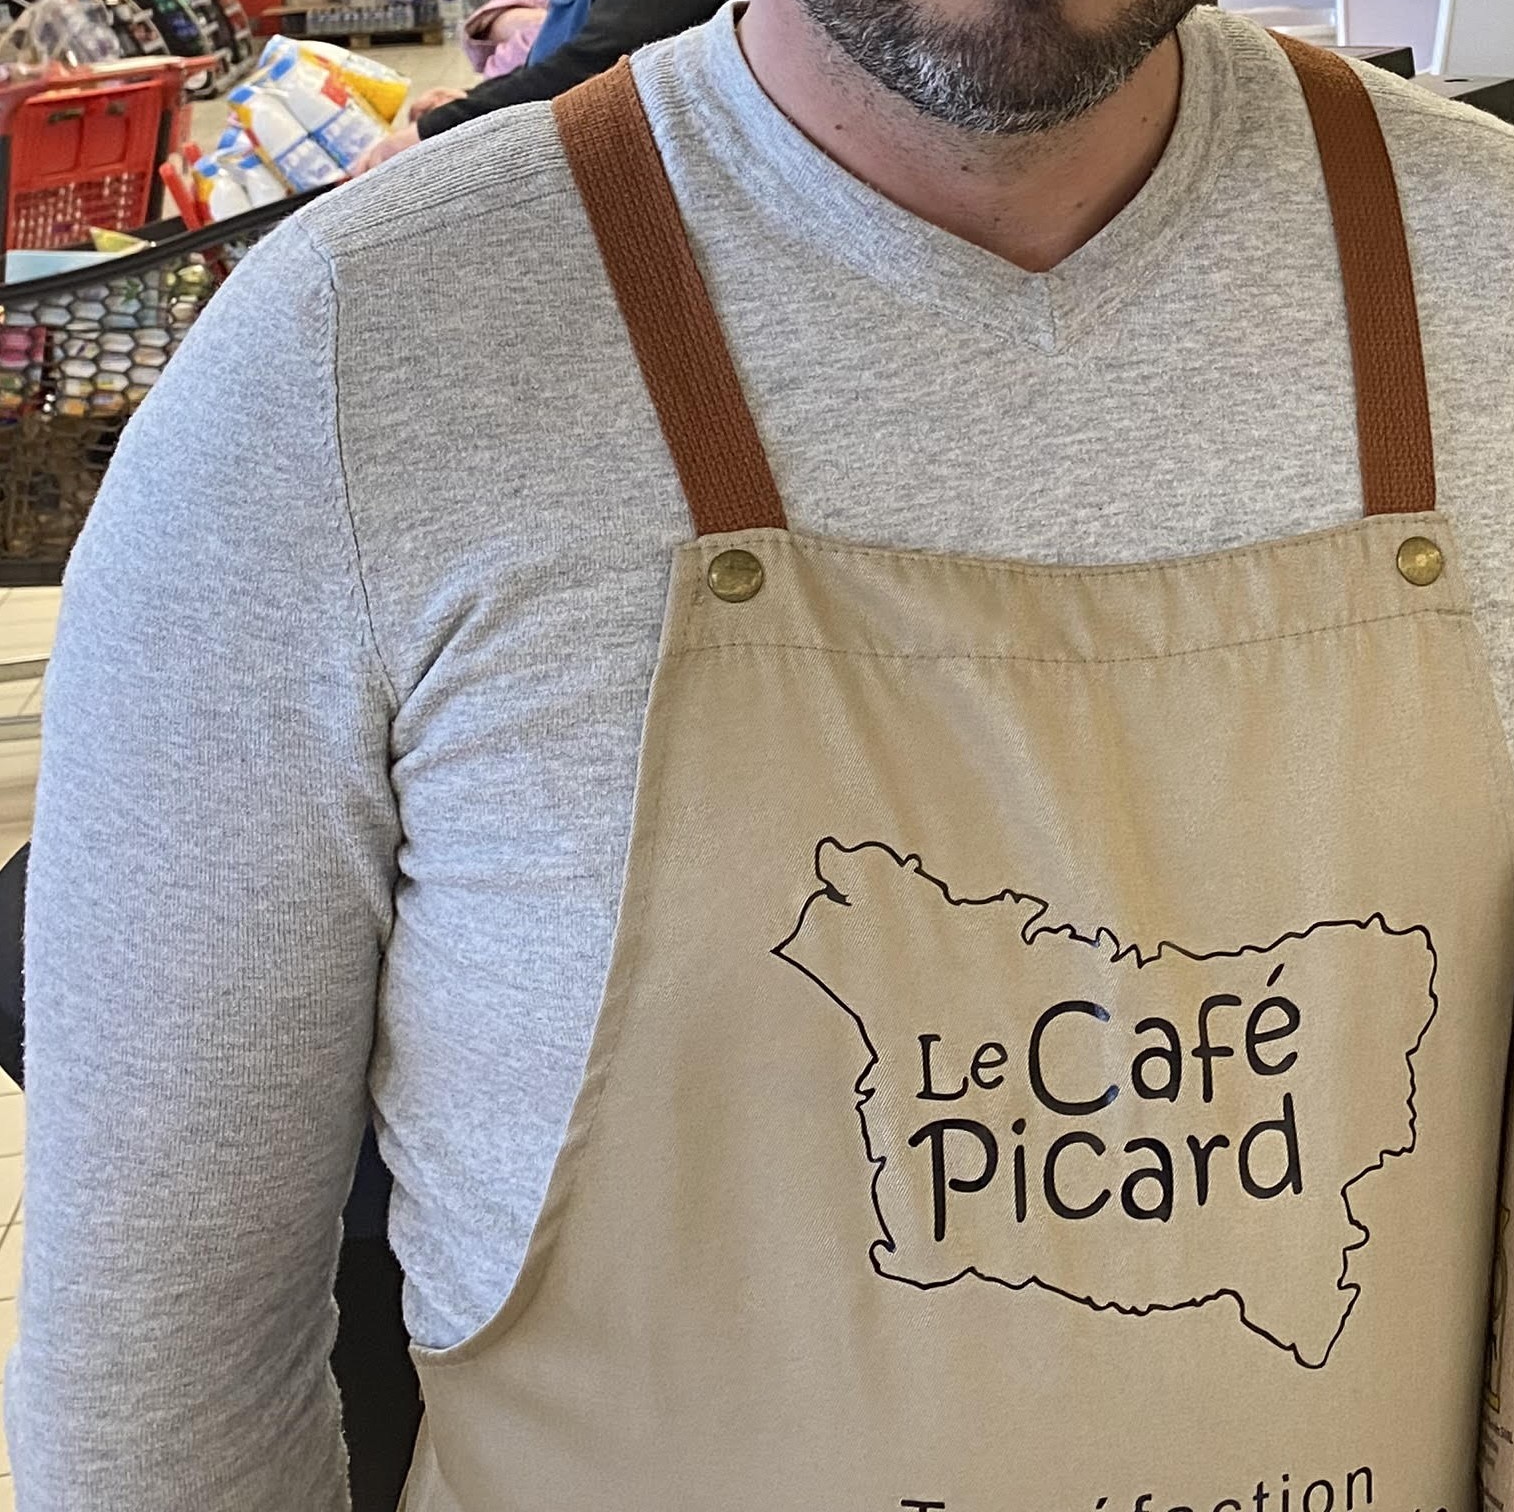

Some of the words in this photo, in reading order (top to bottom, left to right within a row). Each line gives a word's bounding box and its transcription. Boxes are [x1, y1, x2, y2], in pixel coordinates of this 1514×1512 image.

[916, 1033, 1008, 1101] Le
[1028, 963, 1301, 1116] Café
[908, 1092, 1303, 1243] Picard
